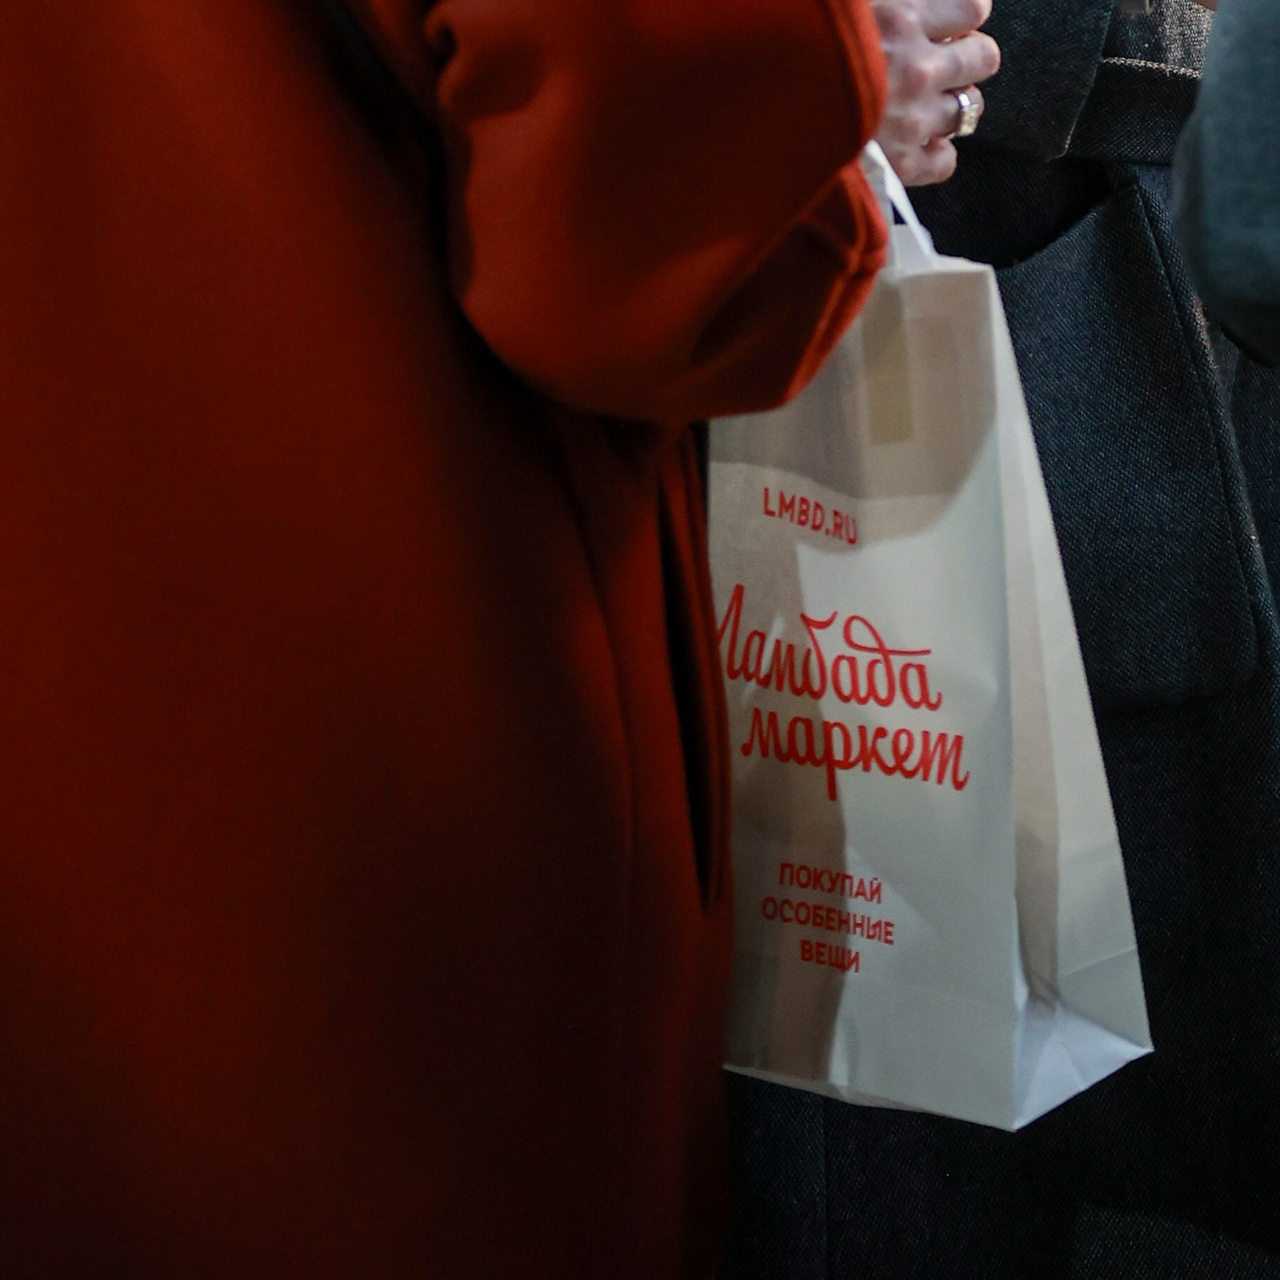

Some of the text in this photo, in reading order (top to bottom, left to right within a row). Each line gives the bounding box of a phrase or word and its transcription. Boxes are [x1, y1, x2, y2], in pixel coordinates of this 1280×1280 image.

[763, 486, 859, 545] LMBD.RU
[740, 706, 970, 801] маркет
[779, 862, 882, 904] ПОКУПАЙ
[762, 896, 895, 945] ОСОБЕННЫЕ
[801, 939, 860, 973] ВЕЩИ
